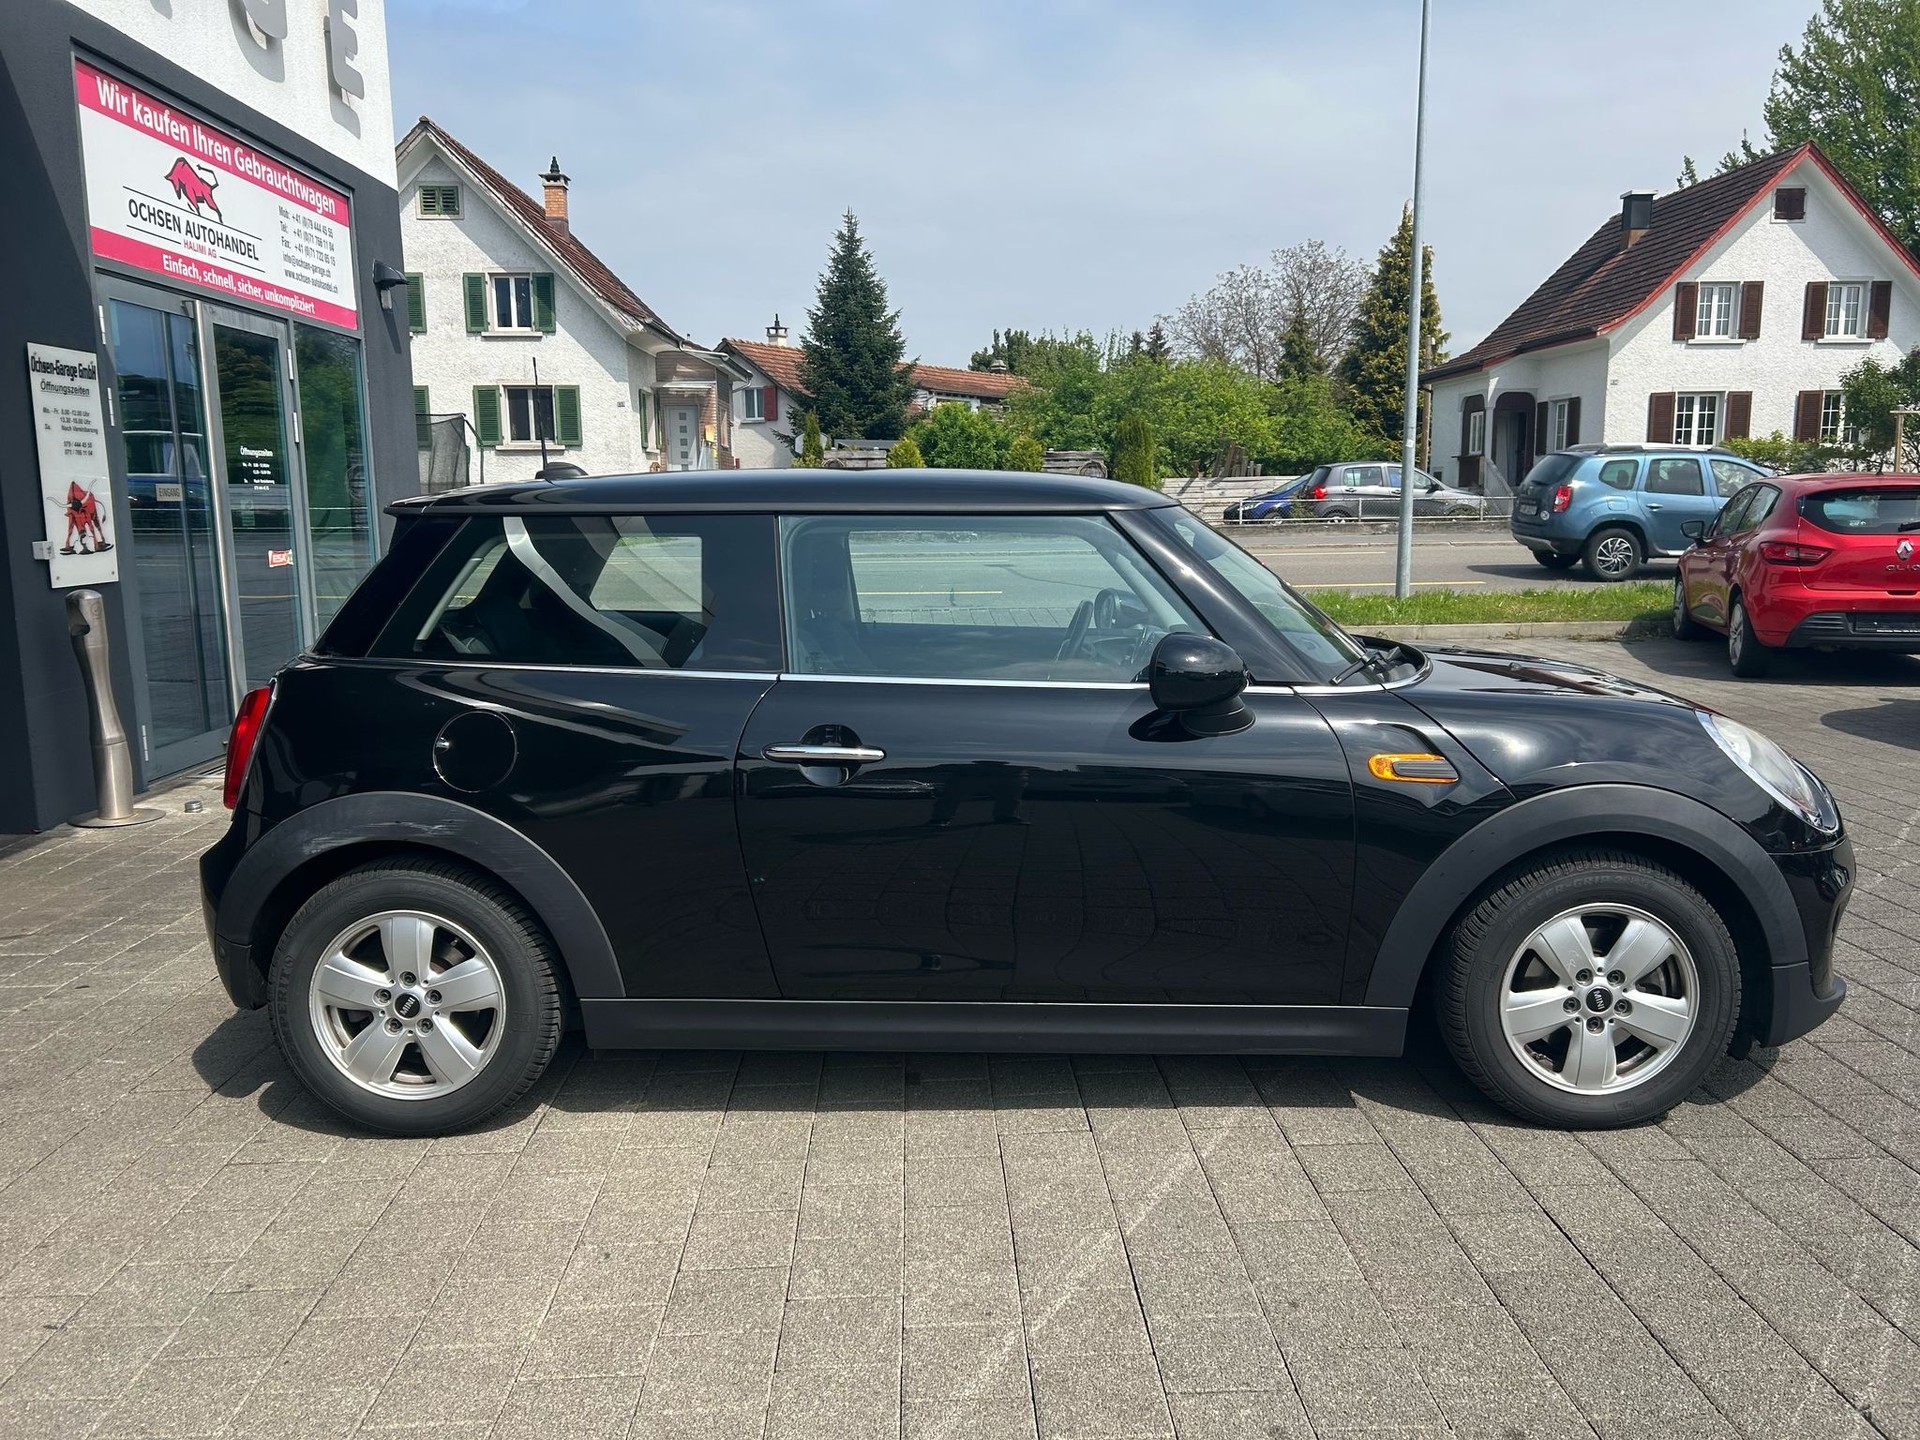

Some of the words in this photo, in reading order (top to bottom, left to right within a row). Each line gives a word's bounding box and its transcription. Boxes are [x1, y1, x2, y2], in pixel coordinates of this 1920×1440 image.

[95, 75, 128, 116] Wir
[132, 92, 190, 146] kaufen
[192, 124, 232, 166] Ihren
[234, 146, 336, 215] Gebrauchtwagen
[128, 198, 182, 234] OCHSEN
[185, 219, 260, 262] AUTOHANDEL
[183, 240, 206, 255] HALIMI
[207, 247, 218, 259] AG
[162, 253, 201, 282] Einfach,
[203, 268, 236, 292] schnell,
[237, 278, 264, 300] sicher,
[265, 288, 316, 315] unkompliziert
[30, 355, 77, 381] Ochsen-Garage
[78, 362, 97, 381] GmbH
[40, 379, 90, 396] Öffnungszeiten
[399, 996, 416, 1016] MINI
[1593, 990, 1606, 1010] MINI
